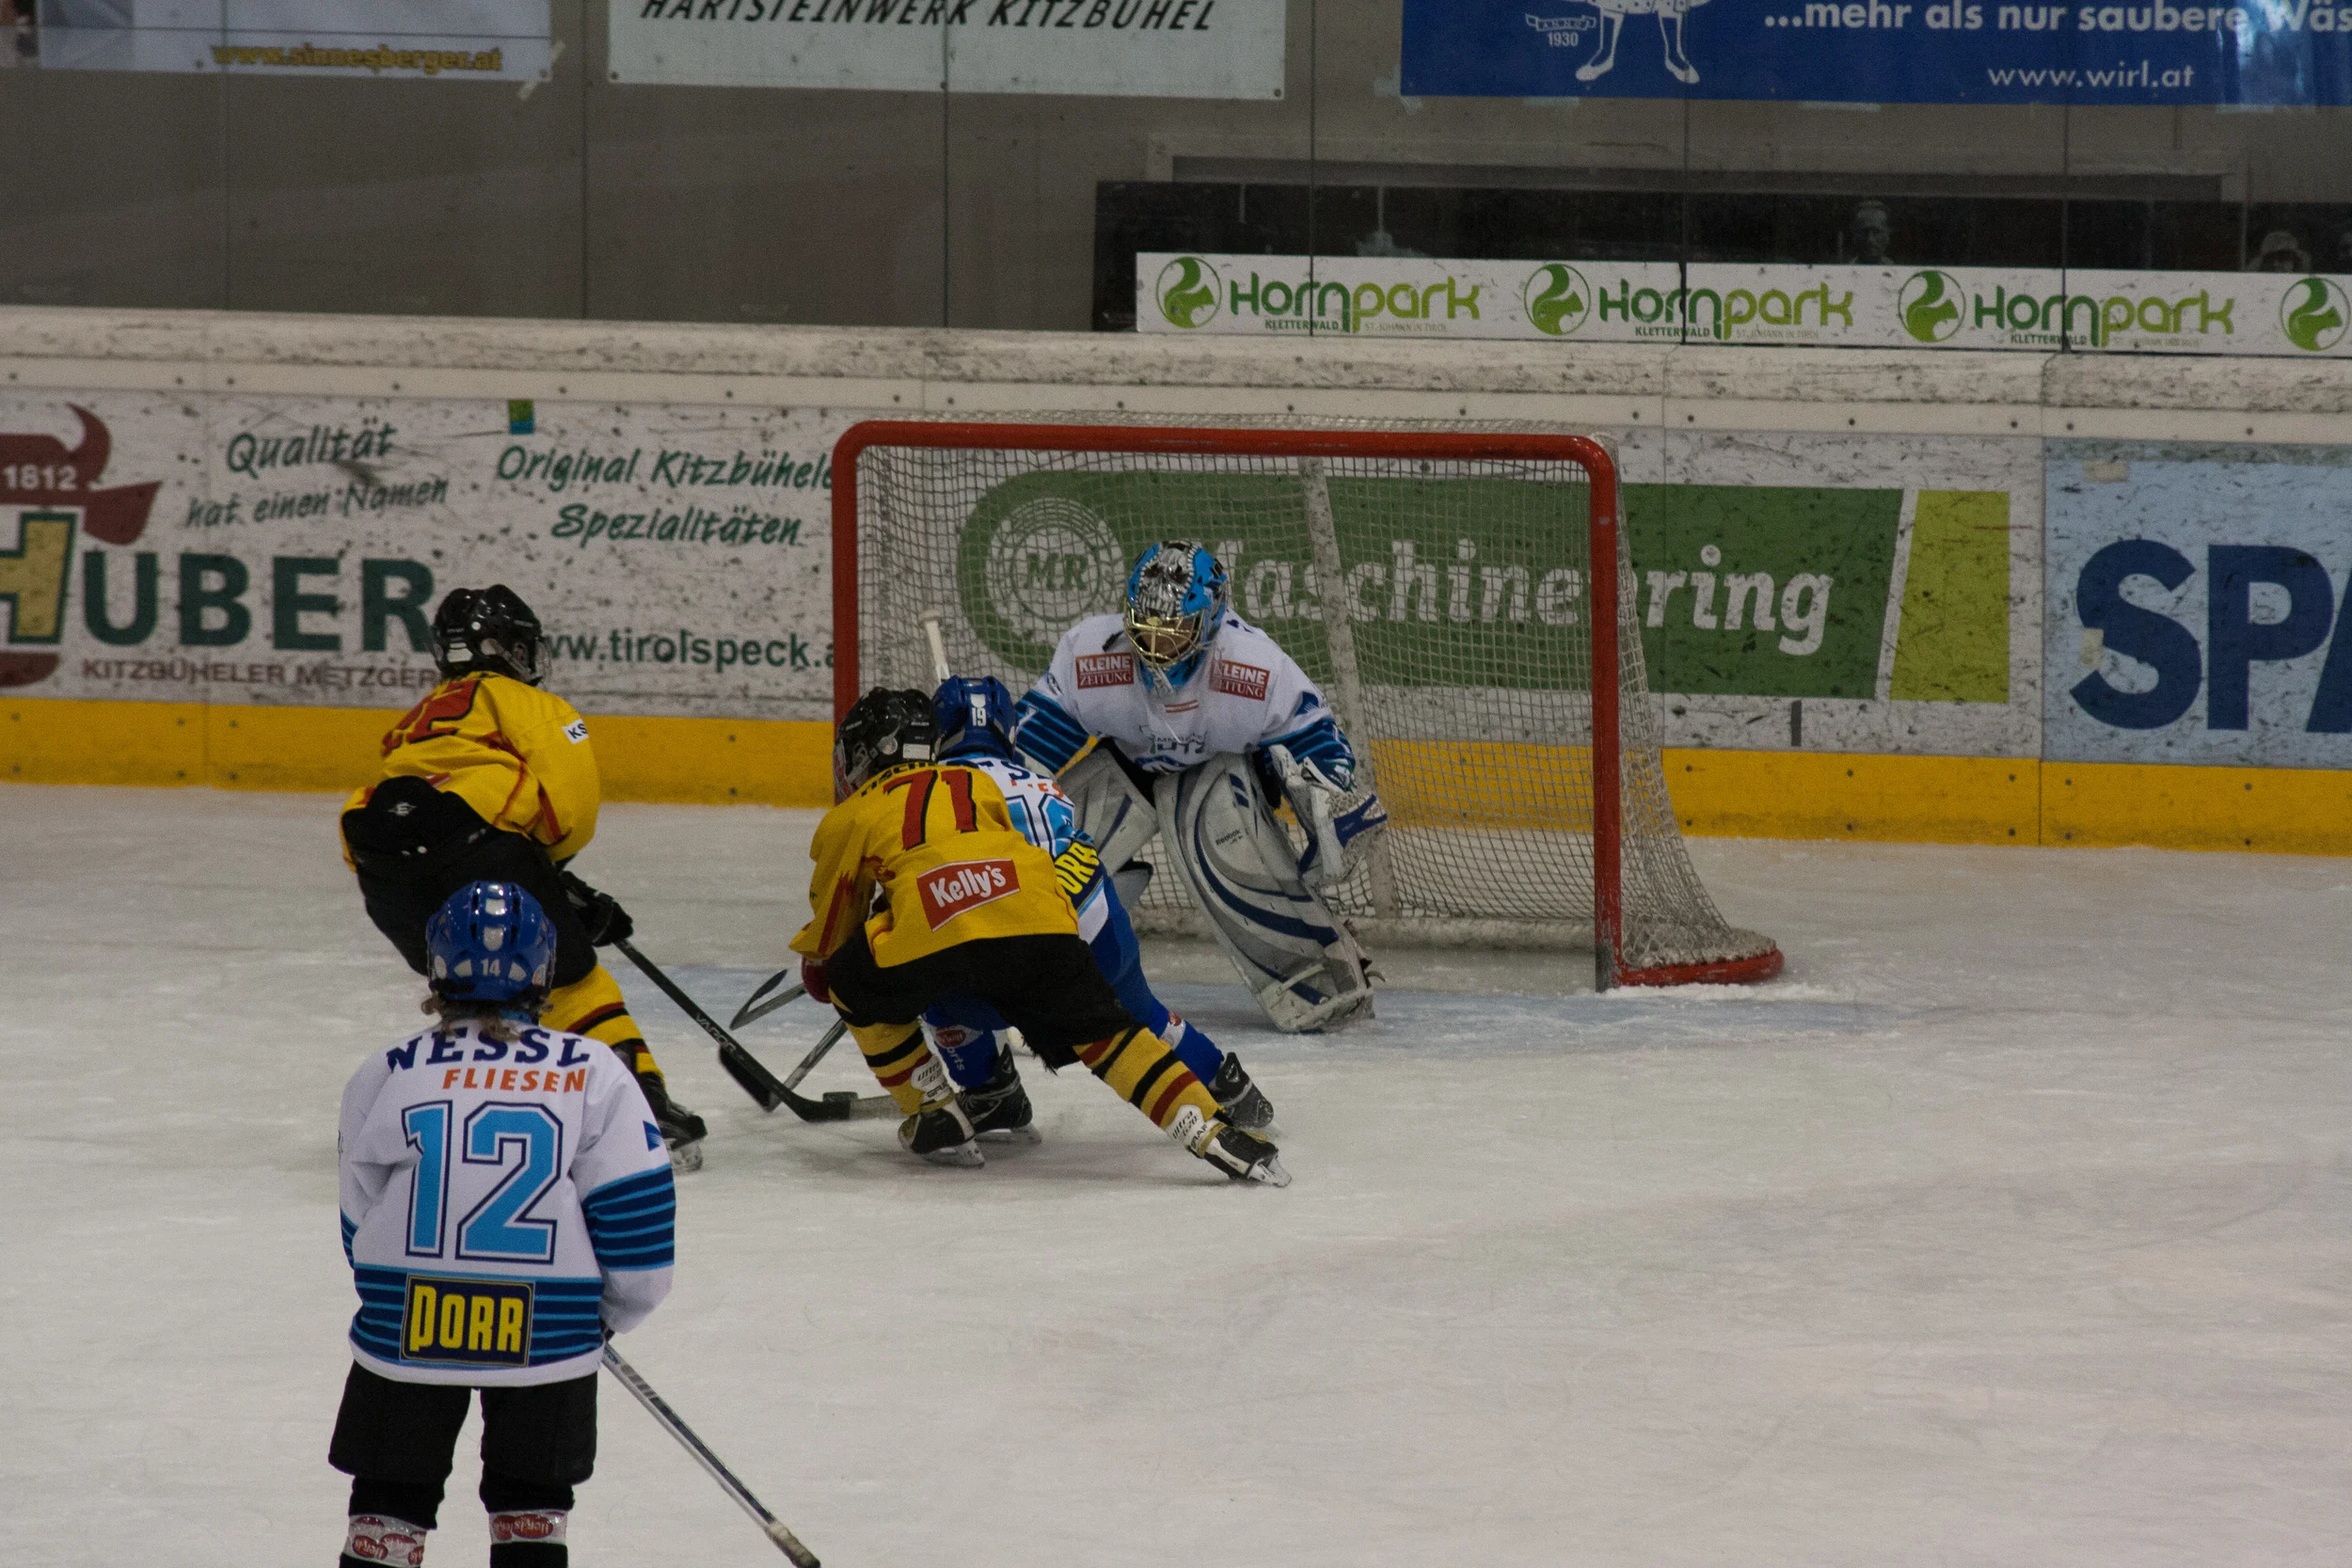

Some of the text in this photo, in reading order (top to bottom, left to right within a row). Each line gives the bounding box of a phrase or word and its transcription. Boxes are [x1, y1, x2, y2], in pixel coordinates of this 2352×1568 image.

[1925, 0, 1982, 30] als
[1998, 4, 2066, 31] nur
[2078, 0, 2249, 32] saubere
[210, 41, 503, 75] www.sinnesberger.at
[1548, 31, 1580, 47] 1930
[1988, 59, 2195, 88] www.wirl.at
[1230, 270, 1481, 334] Hornpark
[1598, 278, 1853, 340] Hornpark
[1975, 285, 2235, 347] Hornpark
[2010, 333, 2088, 345] KLETTERLD
[226, 417, 398, 479] Qualität
[498, 445, 642, 494] Original
[6, 465, 78, 491] 1812
[187, 477, 450, 529] hat einen Namen
[551, 502, 802, 547] Spezialitäten
[1079, 655, 1130, 673] KLEINE
[1080, 671, 1133, 688] ZEITUNG
[1217, 678, 1263, 698] EITUNG
[971, 706, 987, 727] 19
[882, 768, 979, 851] 71
[929, 864, 1007, 908] Kelly's
[1055, 842, 1100, 895] ORR
[480, 958, 501, 977] 14
[386, 1027, 590, 1073] NESSL
[442, 1068, 587, 1093] FLIESEN
[401, 1099, 564, 1265] 12
[408, 1284, 525, 1353] PORR
